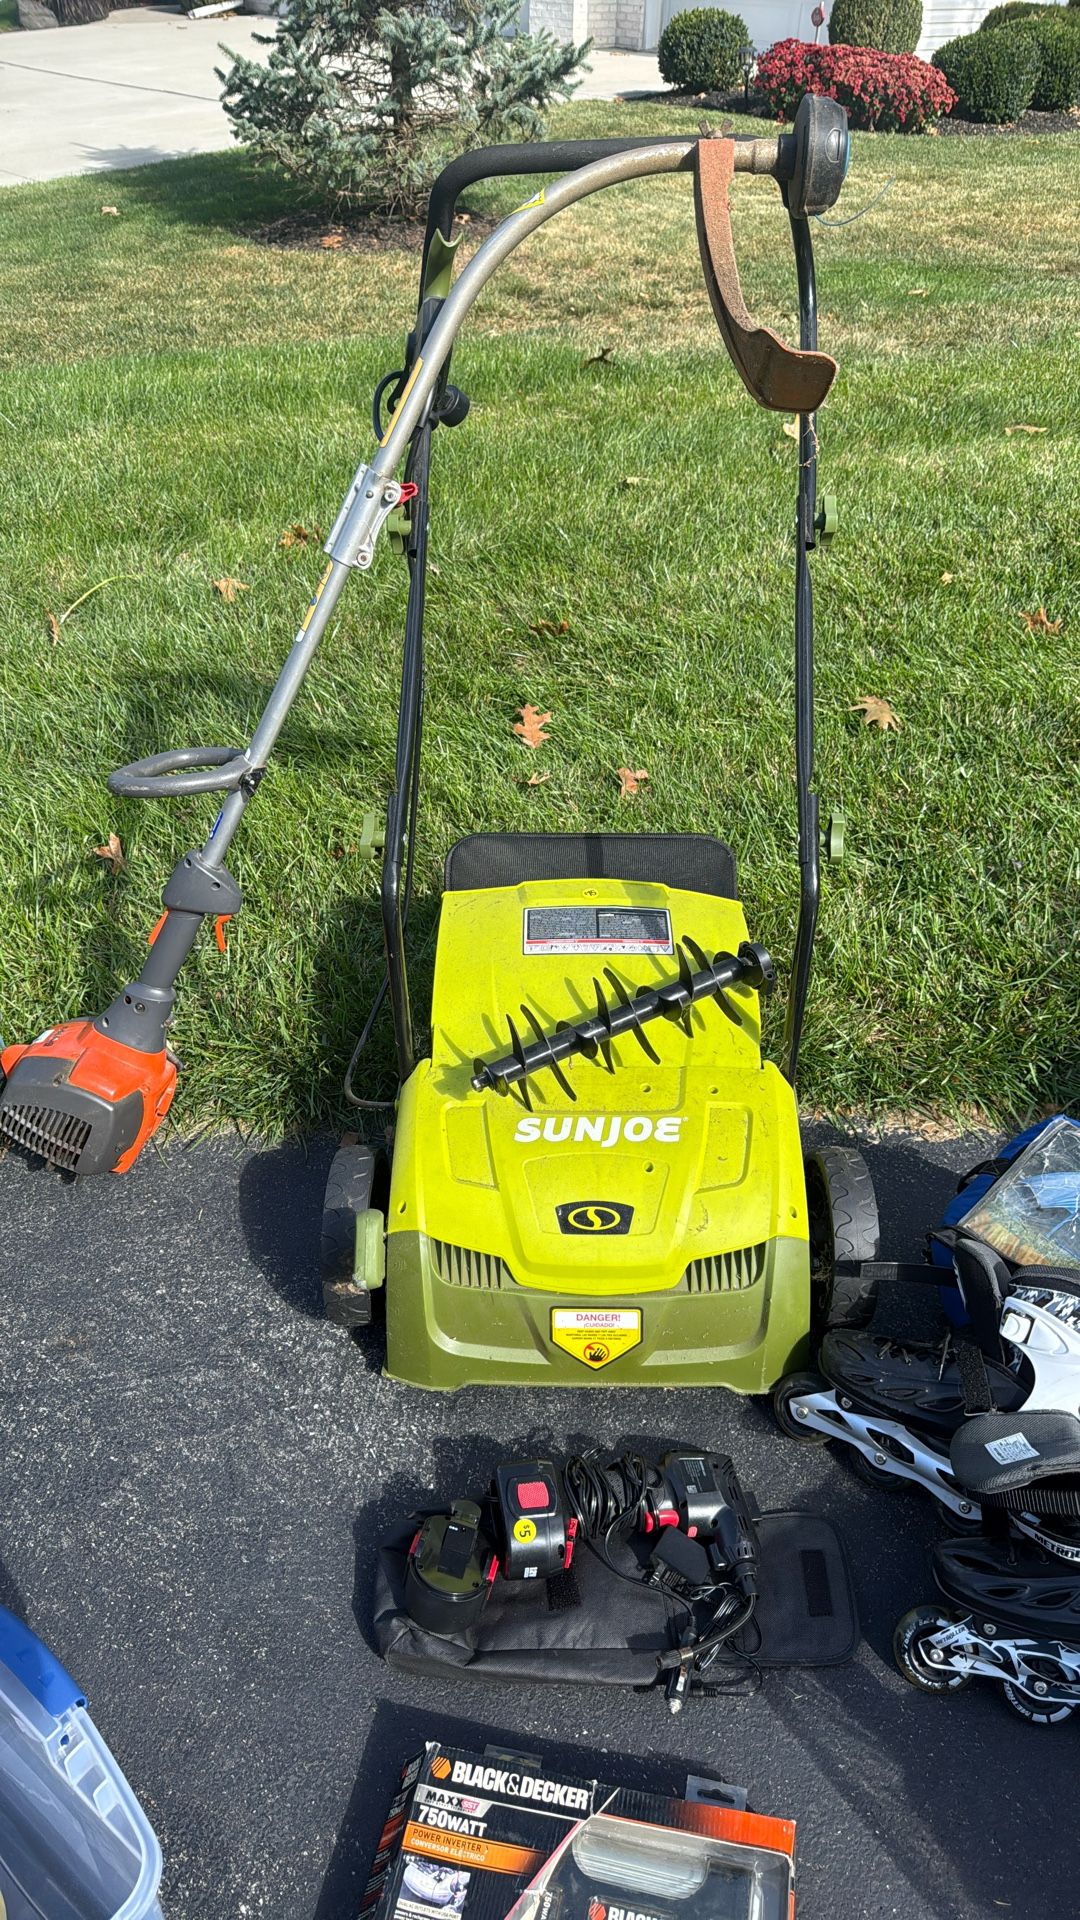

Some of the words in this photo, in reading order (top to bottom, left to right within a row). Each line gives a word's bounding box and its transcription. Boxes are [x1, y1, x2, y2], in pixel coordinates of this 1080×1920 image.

[514, 1116, 682, 1147] SUNJOE
[576, 1313, 621, 1322] DANGER!
[451, 1760, 589, 1811] BLACK&DECKER
[410, 1838, 450, 1854] CONVERSOR
[412, 1828, 441, 1843] POWER
[442, 1835, 482, 1852] INVERTER
